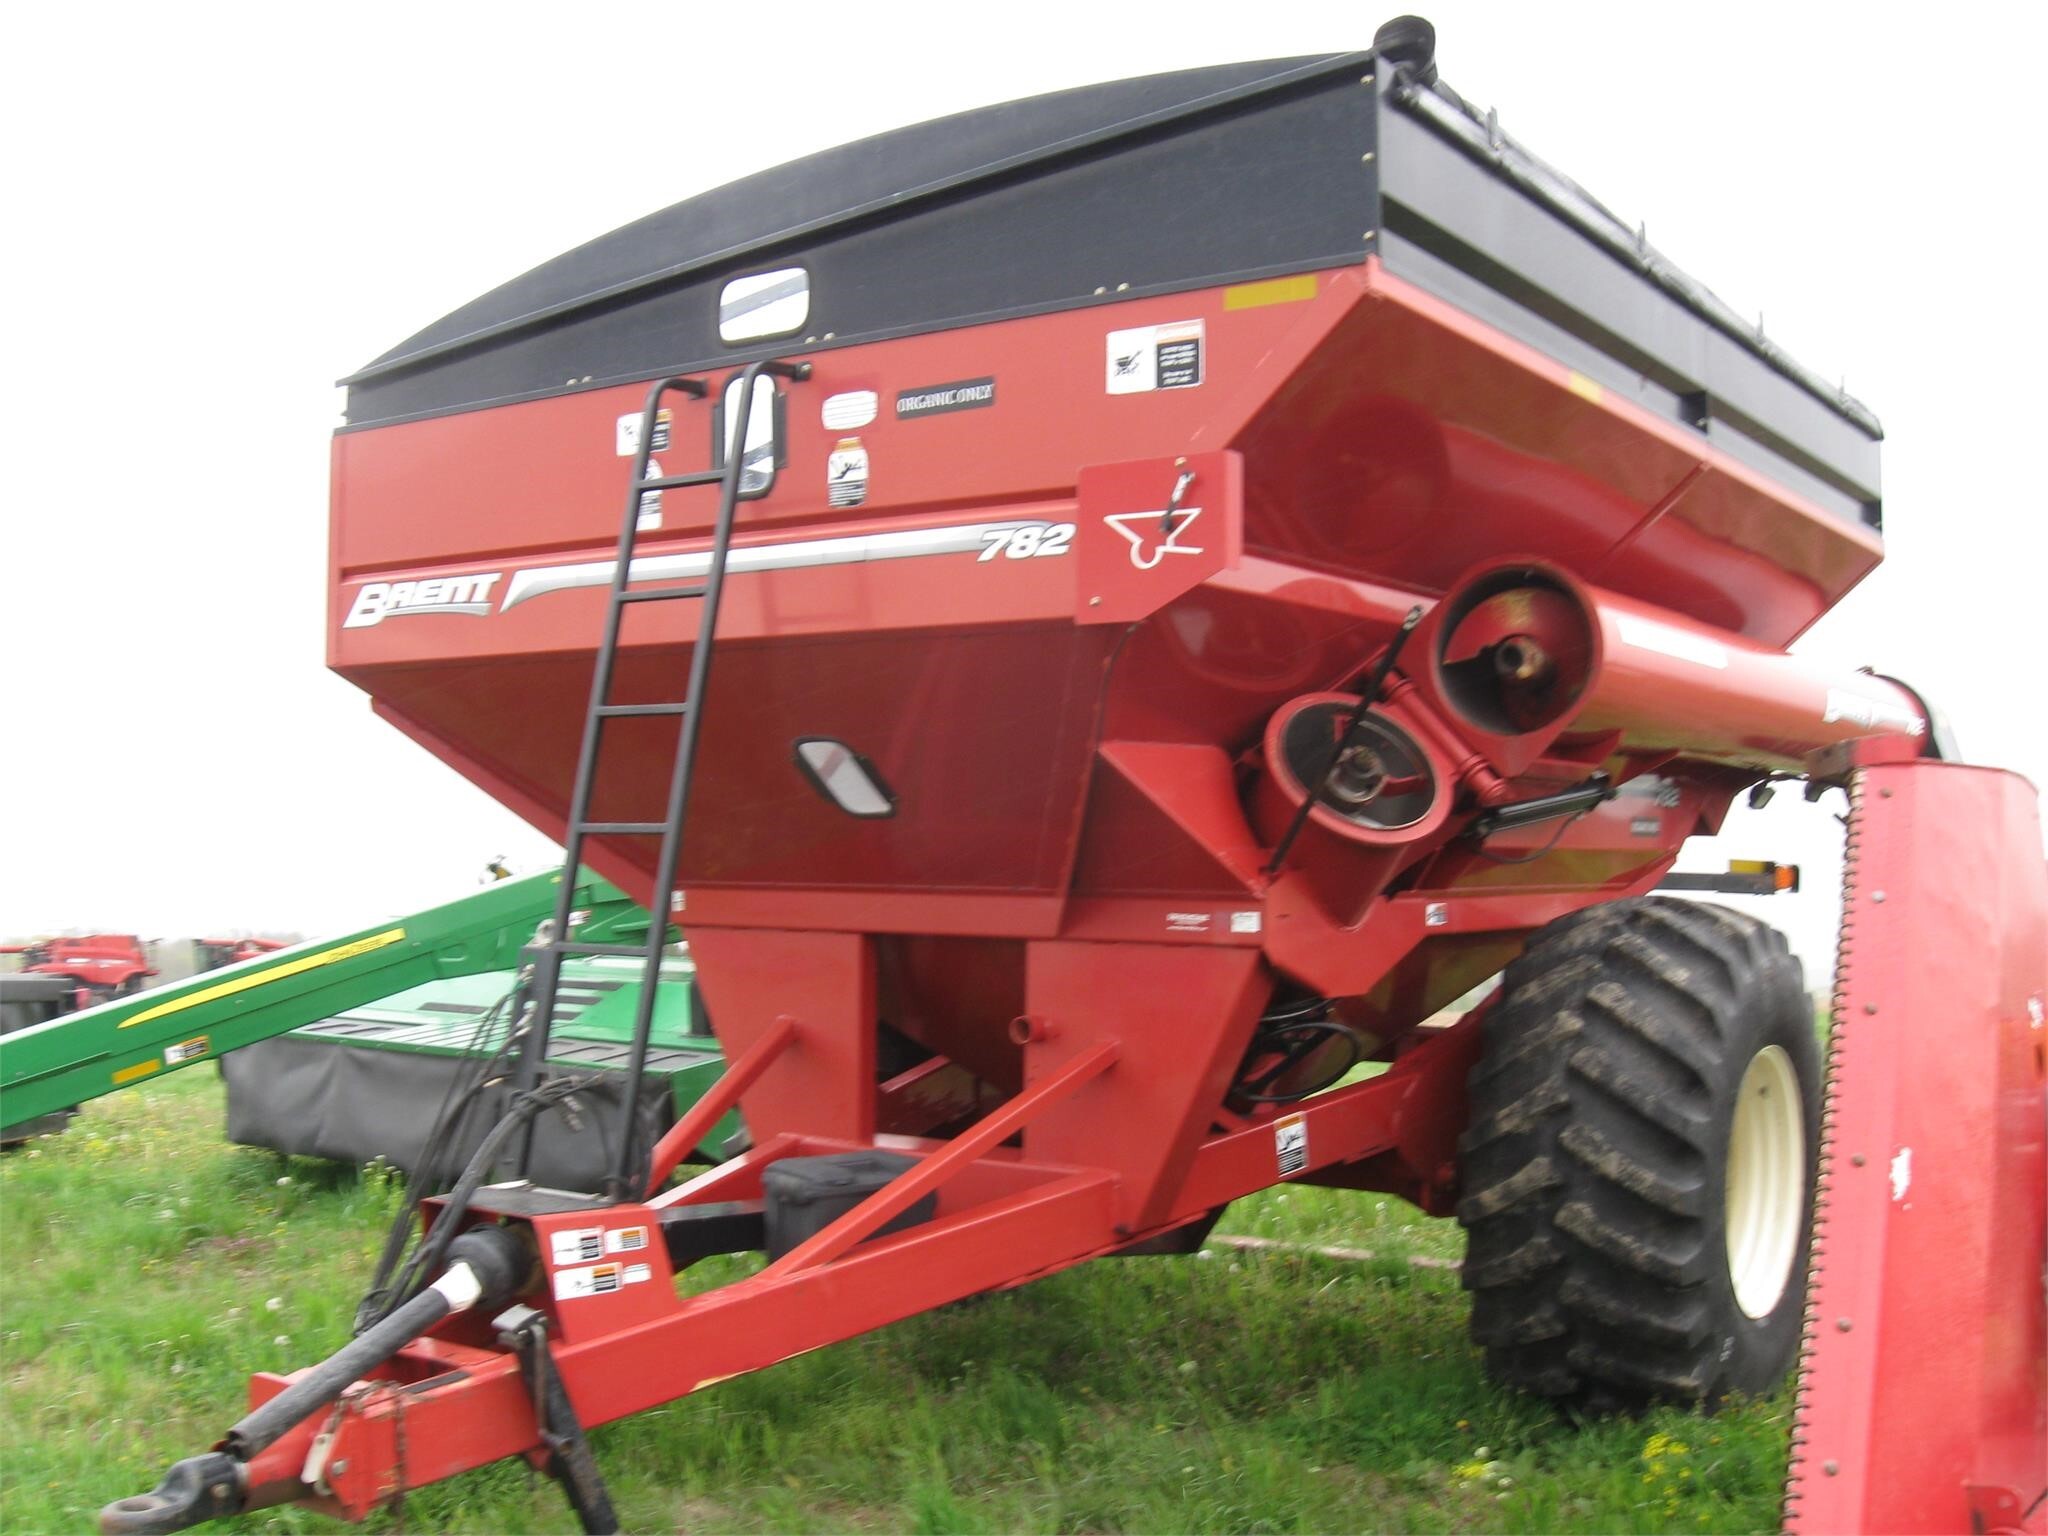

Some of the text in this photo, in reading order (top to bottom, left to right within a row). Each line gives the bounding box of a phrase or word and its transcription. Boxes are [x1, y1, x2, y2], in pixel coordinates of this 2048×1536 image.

[896, 389, 957, 412] ORGANIC
[956, 384, 995, 402] ONLY
[976, 523, 1077, 562] 782
[342, 573, 503, 628] BRENT
